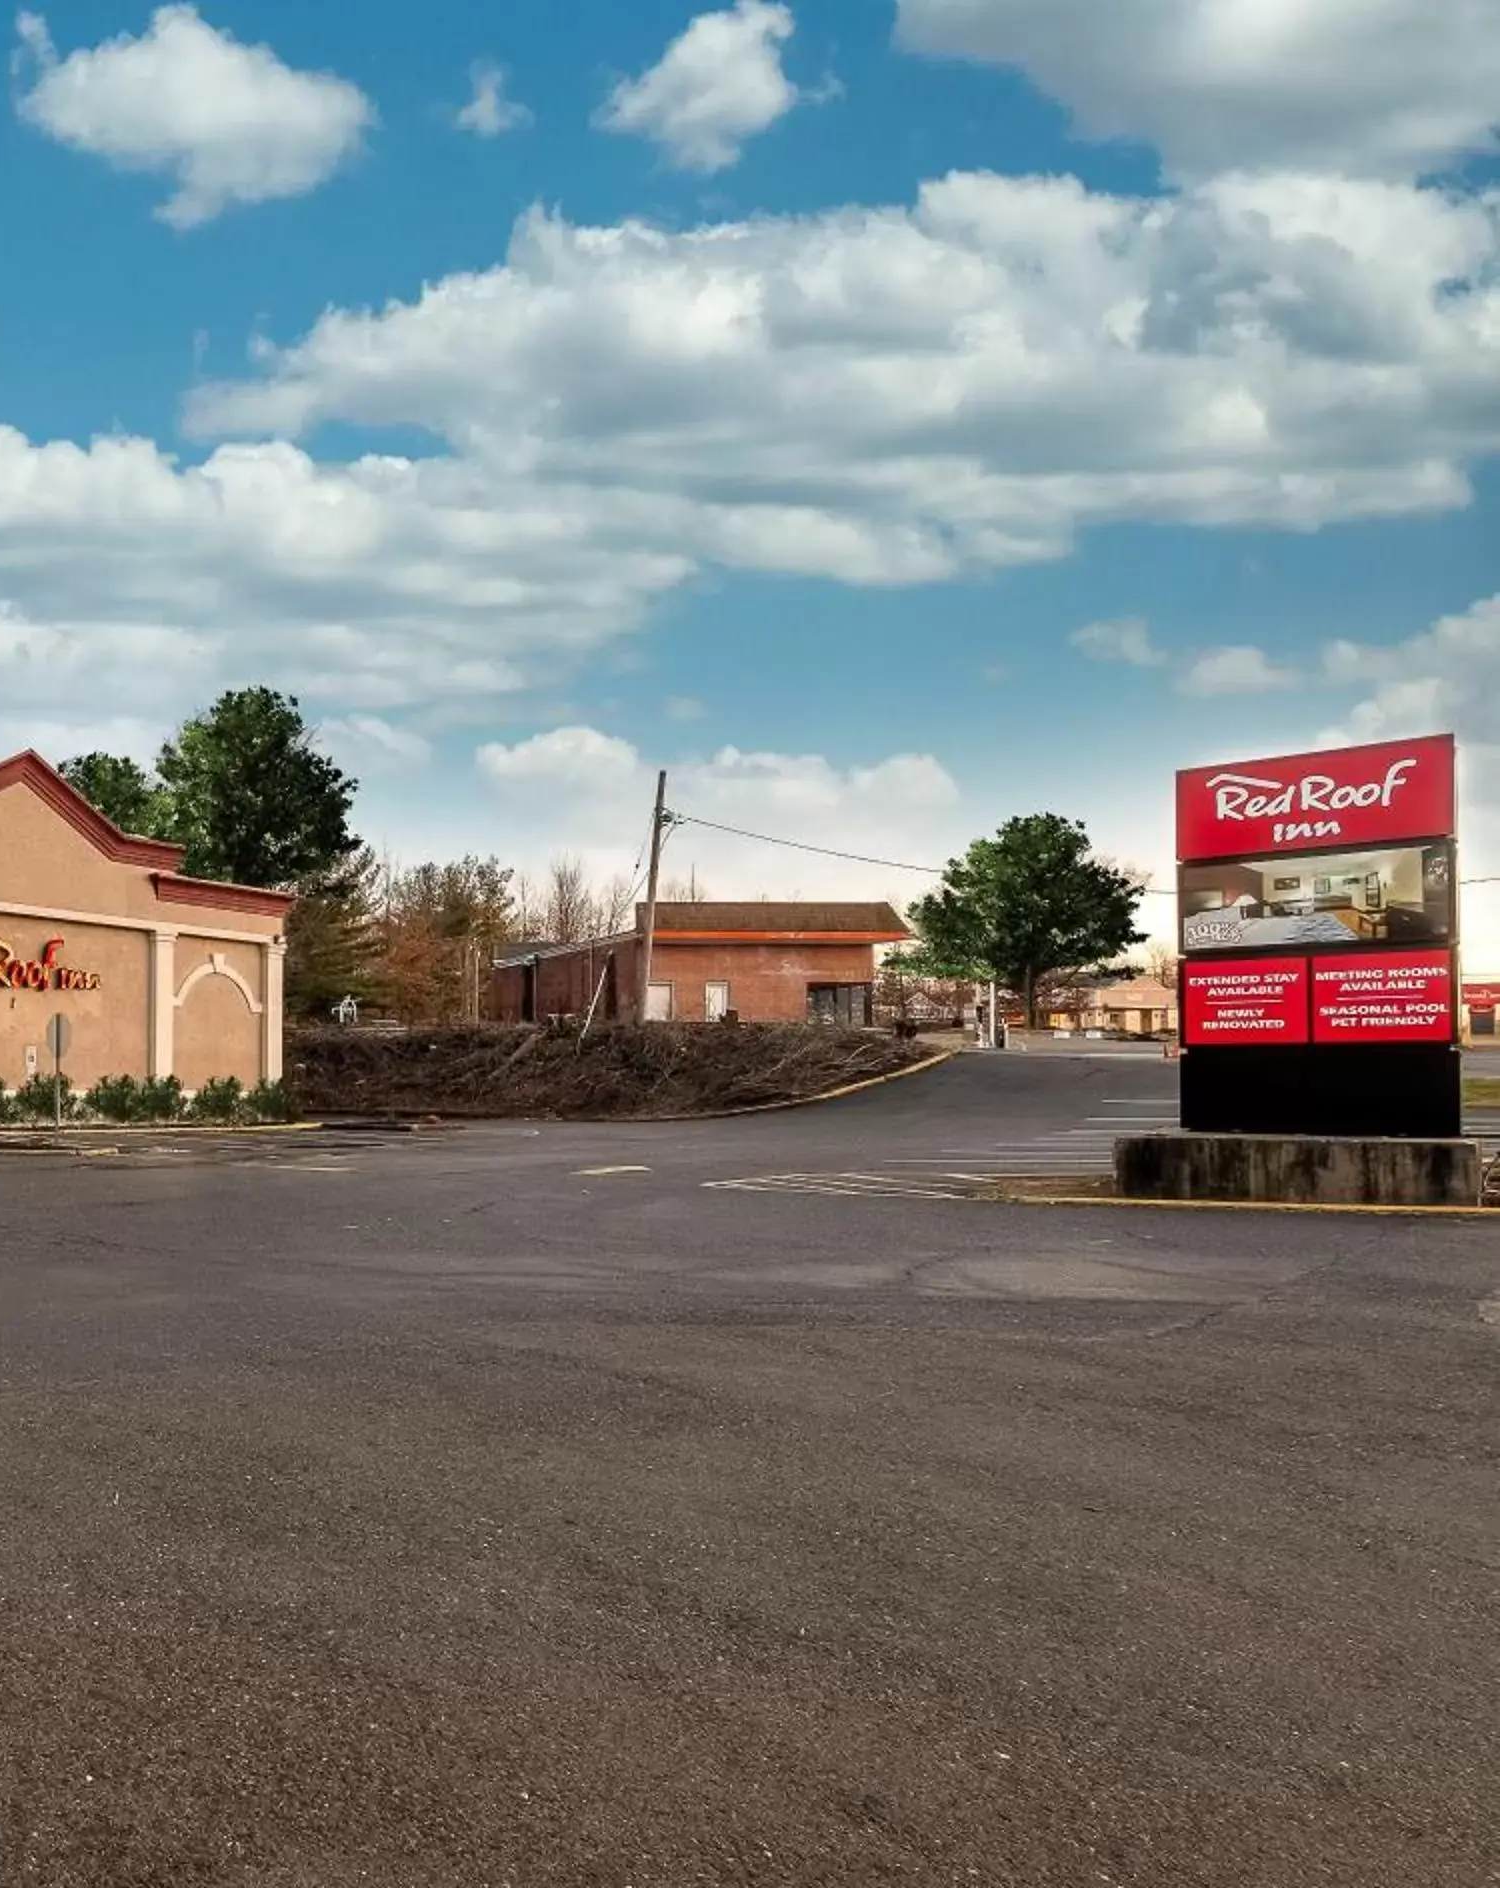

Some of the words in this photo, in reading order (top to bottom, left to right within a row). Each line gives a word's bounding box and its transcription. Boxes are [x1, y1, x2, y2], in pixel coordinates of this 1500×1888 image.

[1215, 782, 1294, 820] Red
[1300, 760, 1417, 810] Roof
[1189, 974, 1261, 986] EXTENDED
[1264, 973, 1299, 983] STAY
[1315, 969, 1383, 981] MEETING
[1387, 967, 1448, 978] ROOMS
[1340, 979, 1426, 991] AVAILABLE
[1207, 986, 1284, 997] AVAILABLE
[1217, 1008, 1265, 1018] NEWLY
[1319, 1004, 1402, 1016] SEASONAL
[1405, 1003, 1449, 1013] POOL
[1202, 1019, 1285, 1030] RENOVATED
[1331, 1017, 1358, 1027] PET
[1361, 1015, 1437, 1027] FRIENDLY
